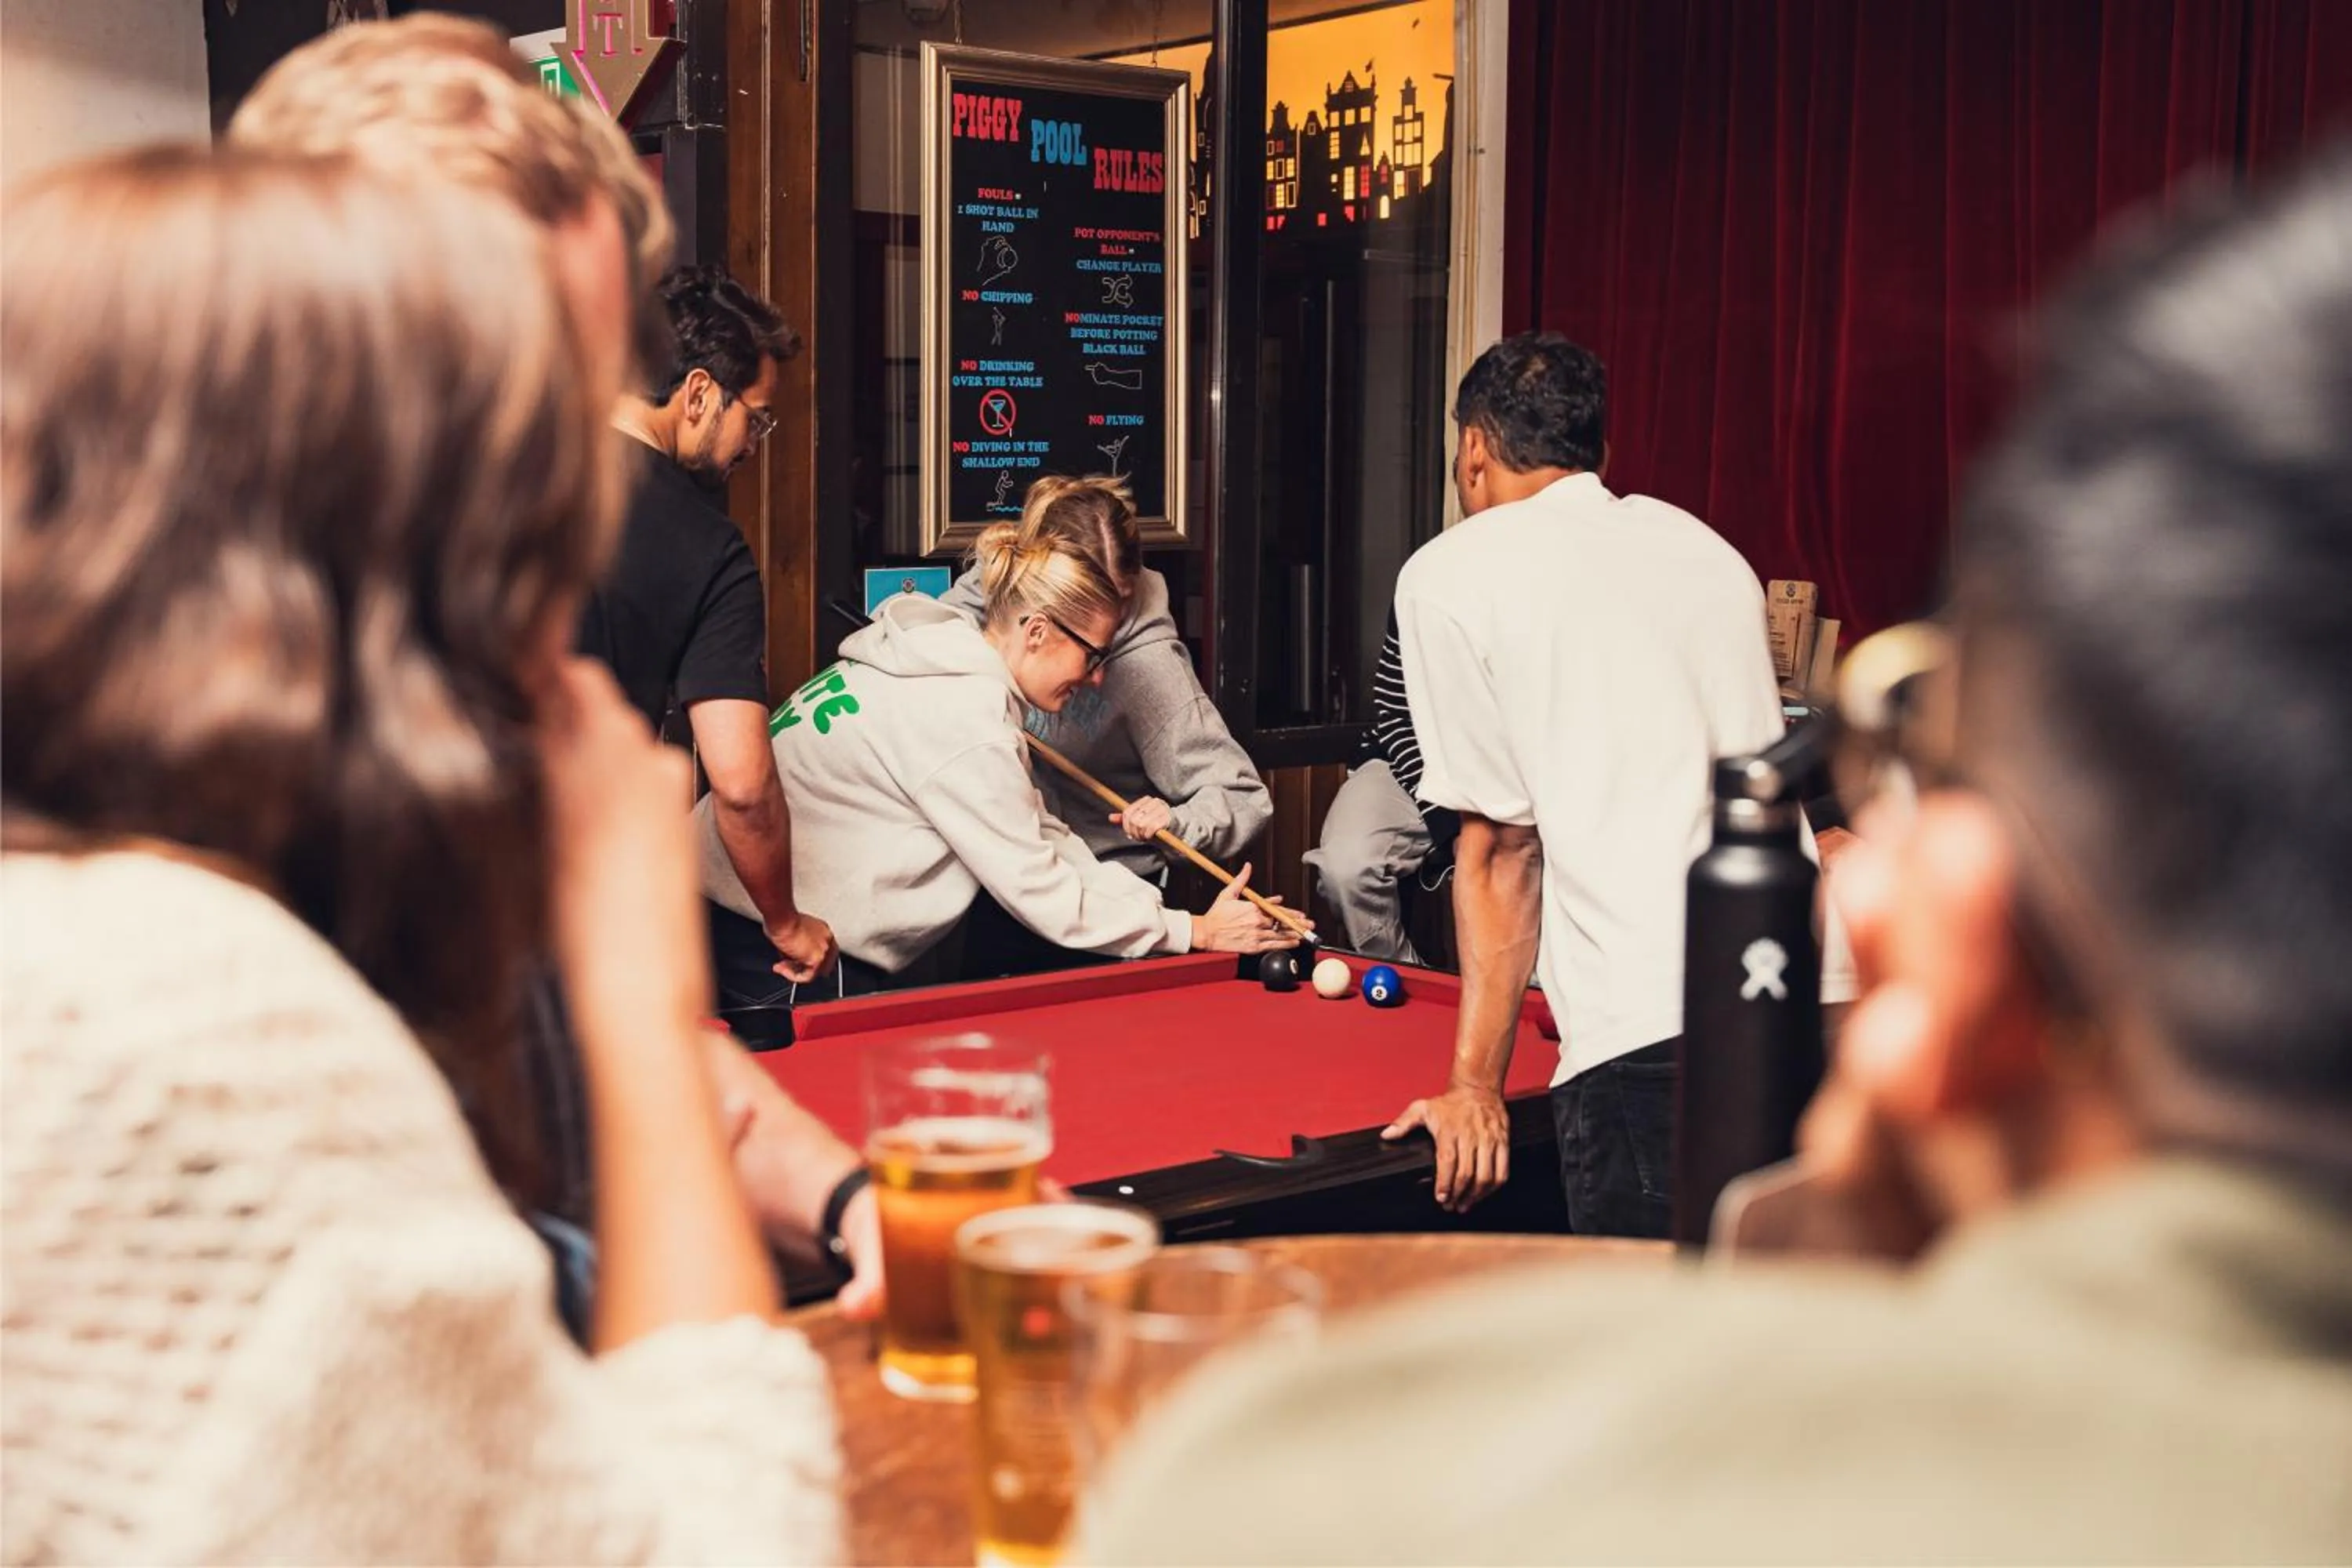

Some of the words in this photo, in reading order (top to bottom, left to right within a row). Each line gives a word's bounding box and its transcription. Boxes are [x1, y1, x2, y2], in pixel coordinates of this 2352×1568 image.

[593, 0, 623, 58] T
[953, 93, 1022, 142] PIGGY
[1031, 119, 1086, 165] POOL
[1094, 147, 1163, 193] RULES
[978, 188, 1014, 199] FOULS
[966, 205, 994, 216] SHOT
[996, 207, 1024, 217] BALL
[1026, 209, 1038, 218] IN
[982, 221, 1014, 232] HAND
[1075, 227, 1094, 238] POT
[1101, 245, 1127, 254] BALL
[1076, 260, 1120, 270] CHANGE
[1123, 262, 1162, 273] PLAYER
[963, 290, 978, 300] NO
[981, 291, 1033, 303] CHIPPING
[1065, 313, 1120, 324] NOMINATE
[1123, 315, 1163, 325] POCKET
[1071, 328, 1110, 339] BEFORE
[1113, 329, 1157, 340] POTTING
[1083, 343, 1118, 354] BLACK
[1120, 345, 1145, 354] BALL
[961, 361, 978, 370] NO
[979, 361, 1033, 372] DRINKING
[953, 376, 983, 386] OVER
[985, 376, 1007, 386] THE
[1008, 376, 1043, 387] TABLE
[1089, 415, 1104, 425] NO
[1106, 416, 1143, 425] FLYING
[953, 441, 969, 452] NO
[972, 441, 1011, 452] DIVING
[1013, 441, 1025, 452] IN
[1027, 441, 1049, 452] THE
[962, 457, 1015, 467] SHALLOW
[1017, 457, 1040, 466] END
